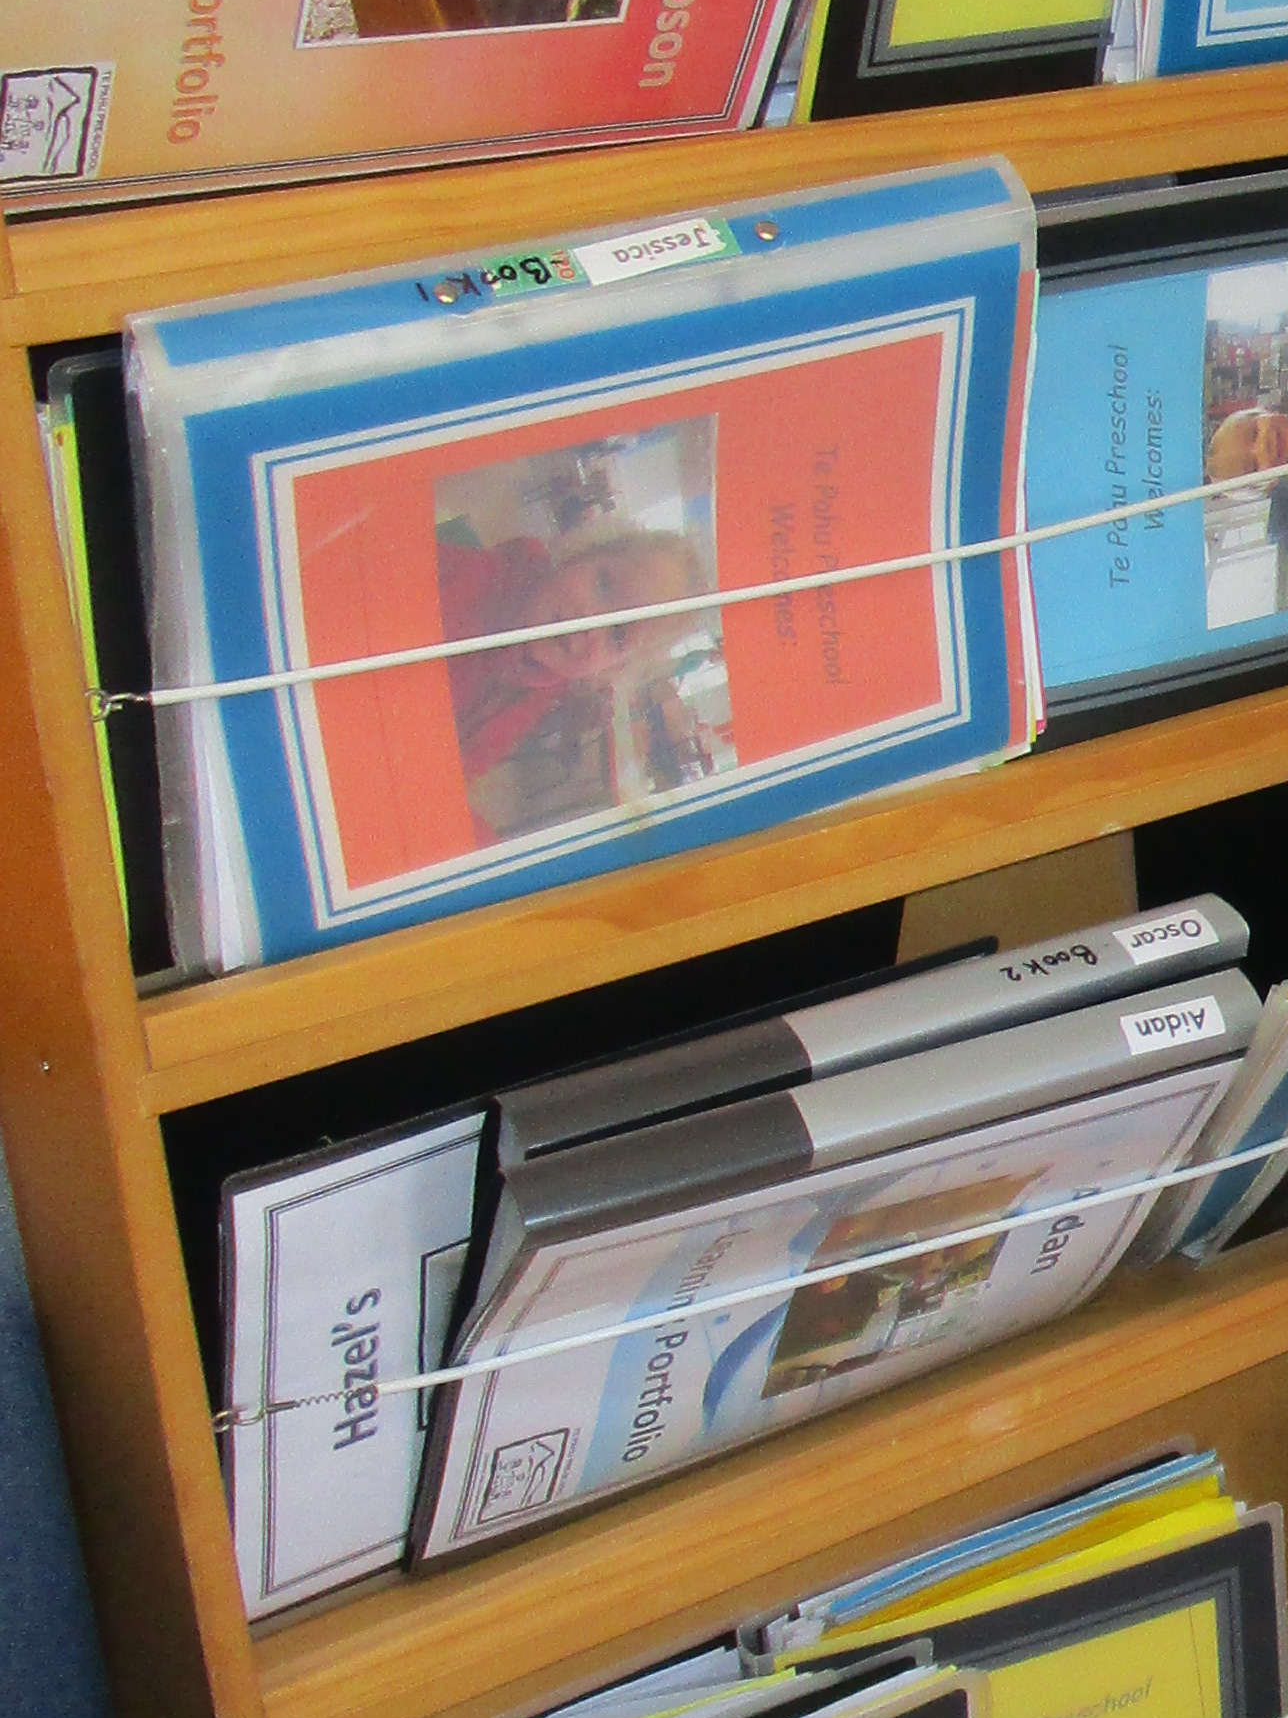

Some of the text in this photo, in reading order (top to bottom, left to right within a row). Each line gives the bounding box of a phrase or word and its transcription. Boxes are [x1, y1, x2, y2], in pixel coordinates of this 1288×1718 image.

[611, 226, 712, 265] Jessica
[1104, 343, 1130, 477] Preschool
[1108, 556, 1131, 589] Te
[815, 553, 850, 686] Peschool
[1022, 943, 1098, 979] Book
[1129, 917, 1203, 948] Oscar
[1134, 1006, 1207, 1037] Aidan
[1029, 1186, 1102, 1277] Adan
[331, 1285, 382, 1454] Hazel's
[621, 1226, 756, 1464] Learnin Portfolio
